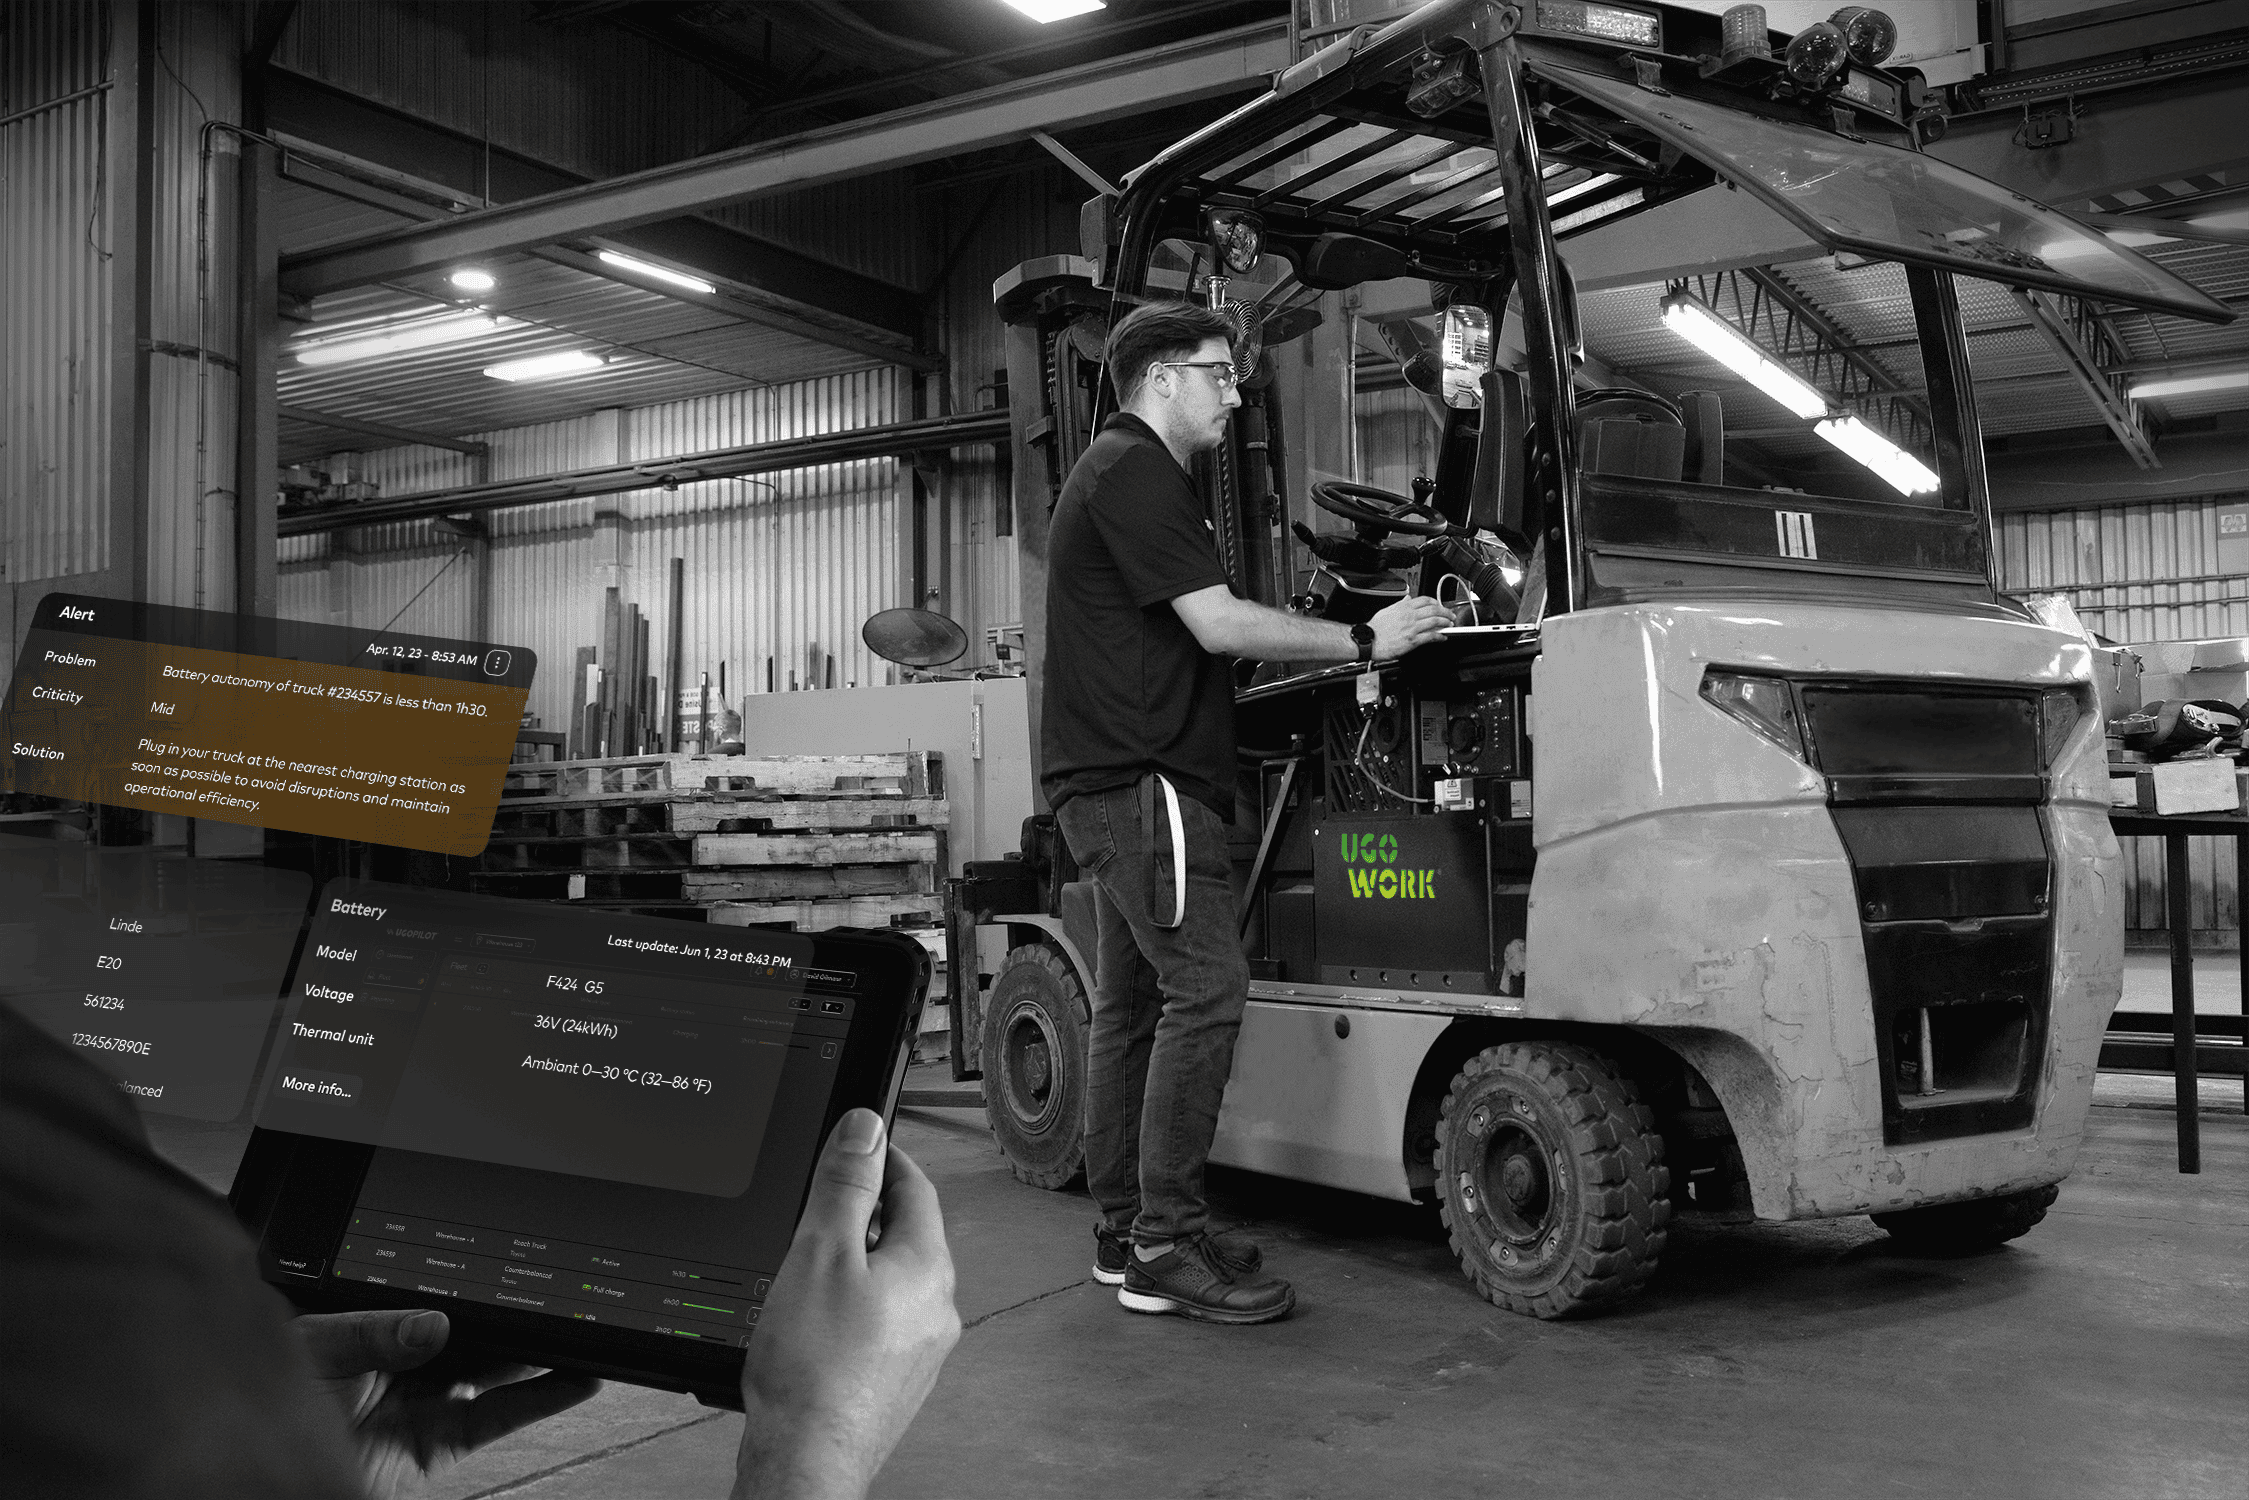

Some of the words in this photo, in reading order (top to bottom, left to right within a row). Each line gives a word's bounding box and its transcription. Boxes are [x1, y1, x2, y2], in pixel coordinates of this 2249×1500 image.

[1341, 833, 1398, 864] UGO
[1348, 868, 1435, 899] WORK
[395, 928, 437, 940] UGOPILOT
[435, 1231, 466, 1242] Warehouse
[426, 1257, 457, 1269] Warehouse
[418, 1284, 448, 1295] Warehouse
